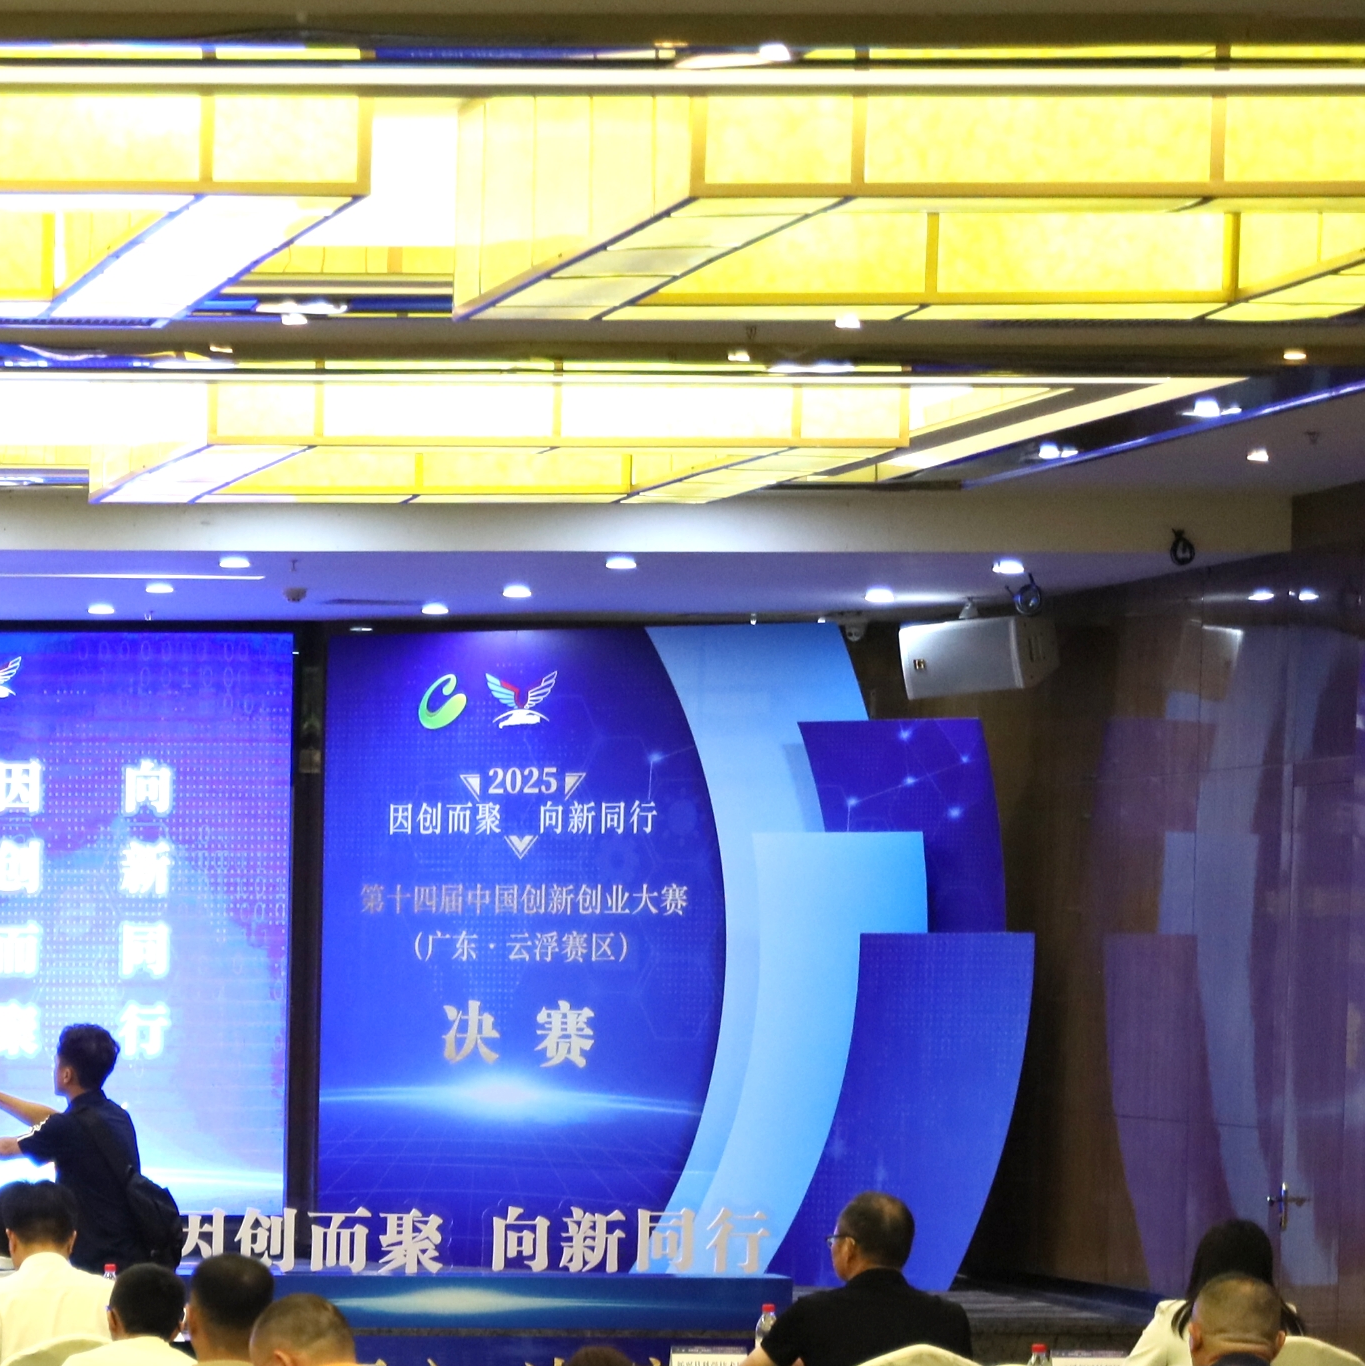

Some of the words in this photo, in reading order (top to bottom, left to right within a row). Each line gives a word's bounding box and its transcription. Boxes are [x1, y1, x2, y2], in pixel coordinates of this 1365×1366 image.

[488, 767, 558, 795] 2025
[388, 802, 501, 835] 因创而聚
[539, 801, 657, 836] 向新同行
[360, 884, 689, 917] 第十四届中国创新创业大赛
[491, 1206, 771, 1273] 向新同行
